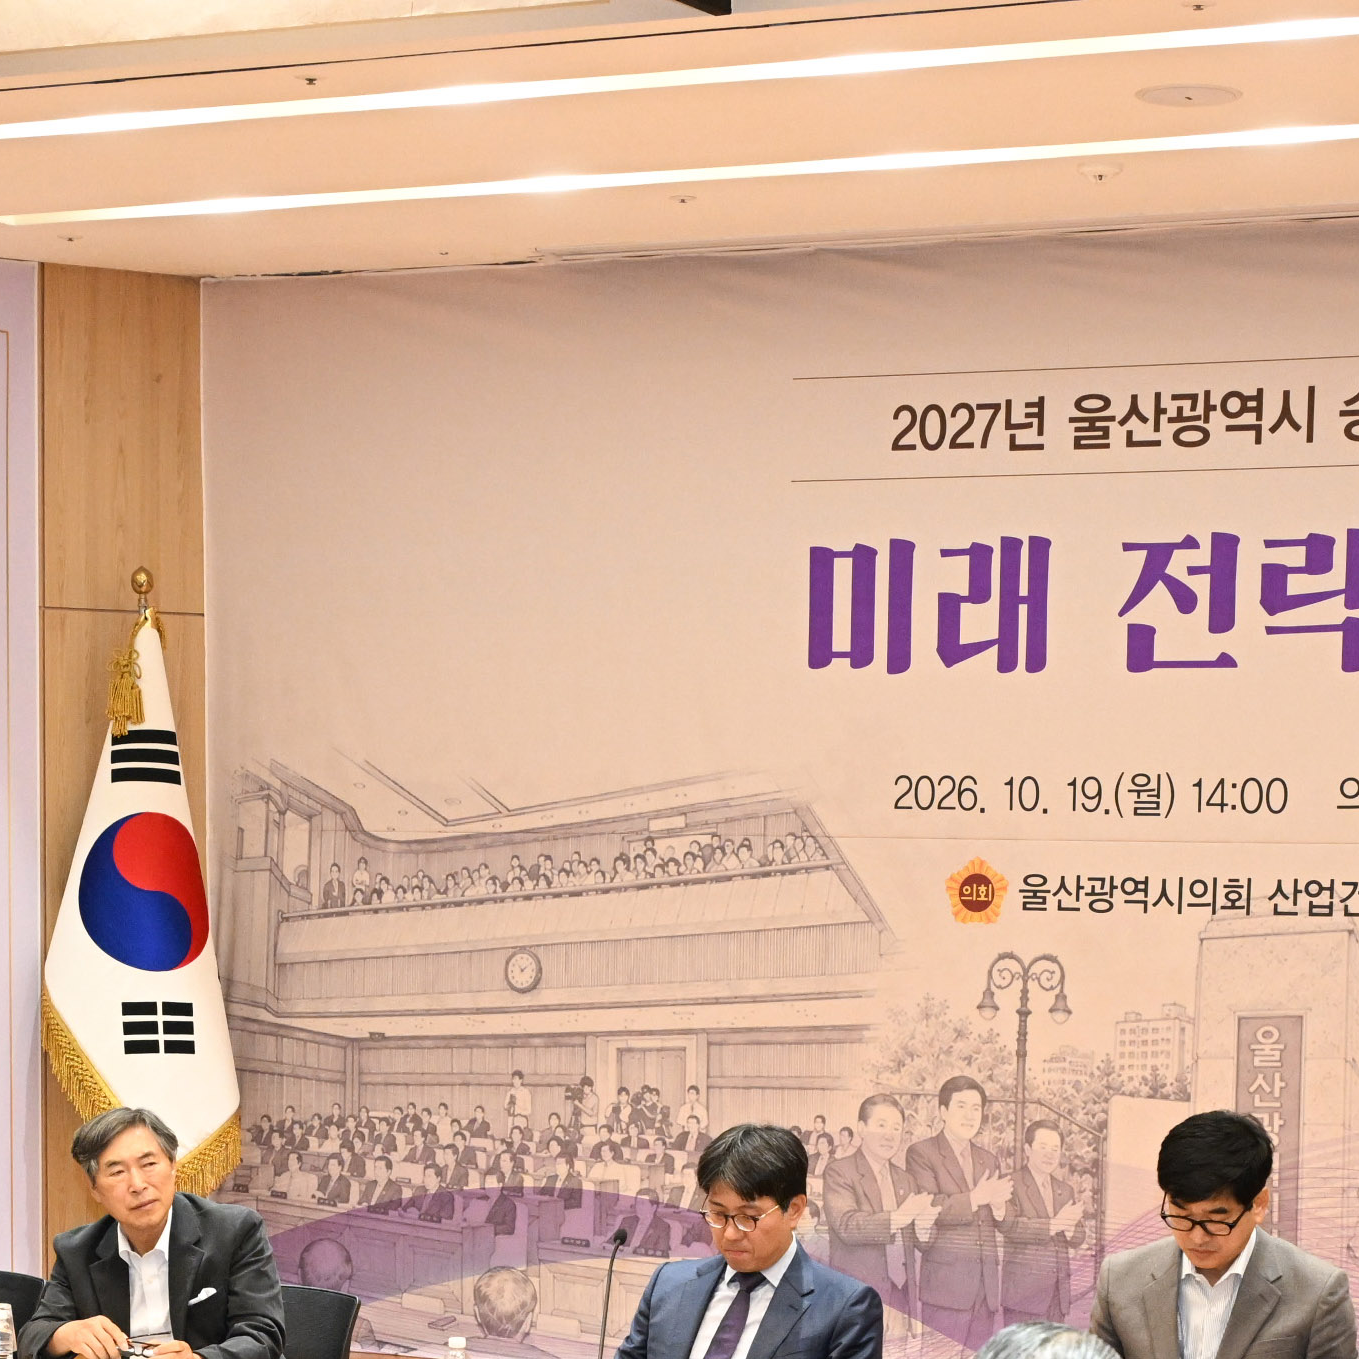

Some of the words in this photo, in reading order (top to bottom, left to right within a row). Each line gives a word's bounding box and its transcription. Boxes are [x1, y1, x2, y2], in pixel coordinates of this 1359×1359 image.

[891, 397, 1045, 452] 2027년
[1068, 385, 1316, 450] 울산광역시
[807, 534, 1052, 675] 미래
[892, 774, 987, 815] 2026.
[1004, 775, 1049, 815] 10.
[1067, 770, 1176, 819] 19.(월)
[1191, 776, 1289, 816] 14:00
[961, 883, 992, 901] 의회
[1018, 873, 1253, 917] 울산광역시의회
